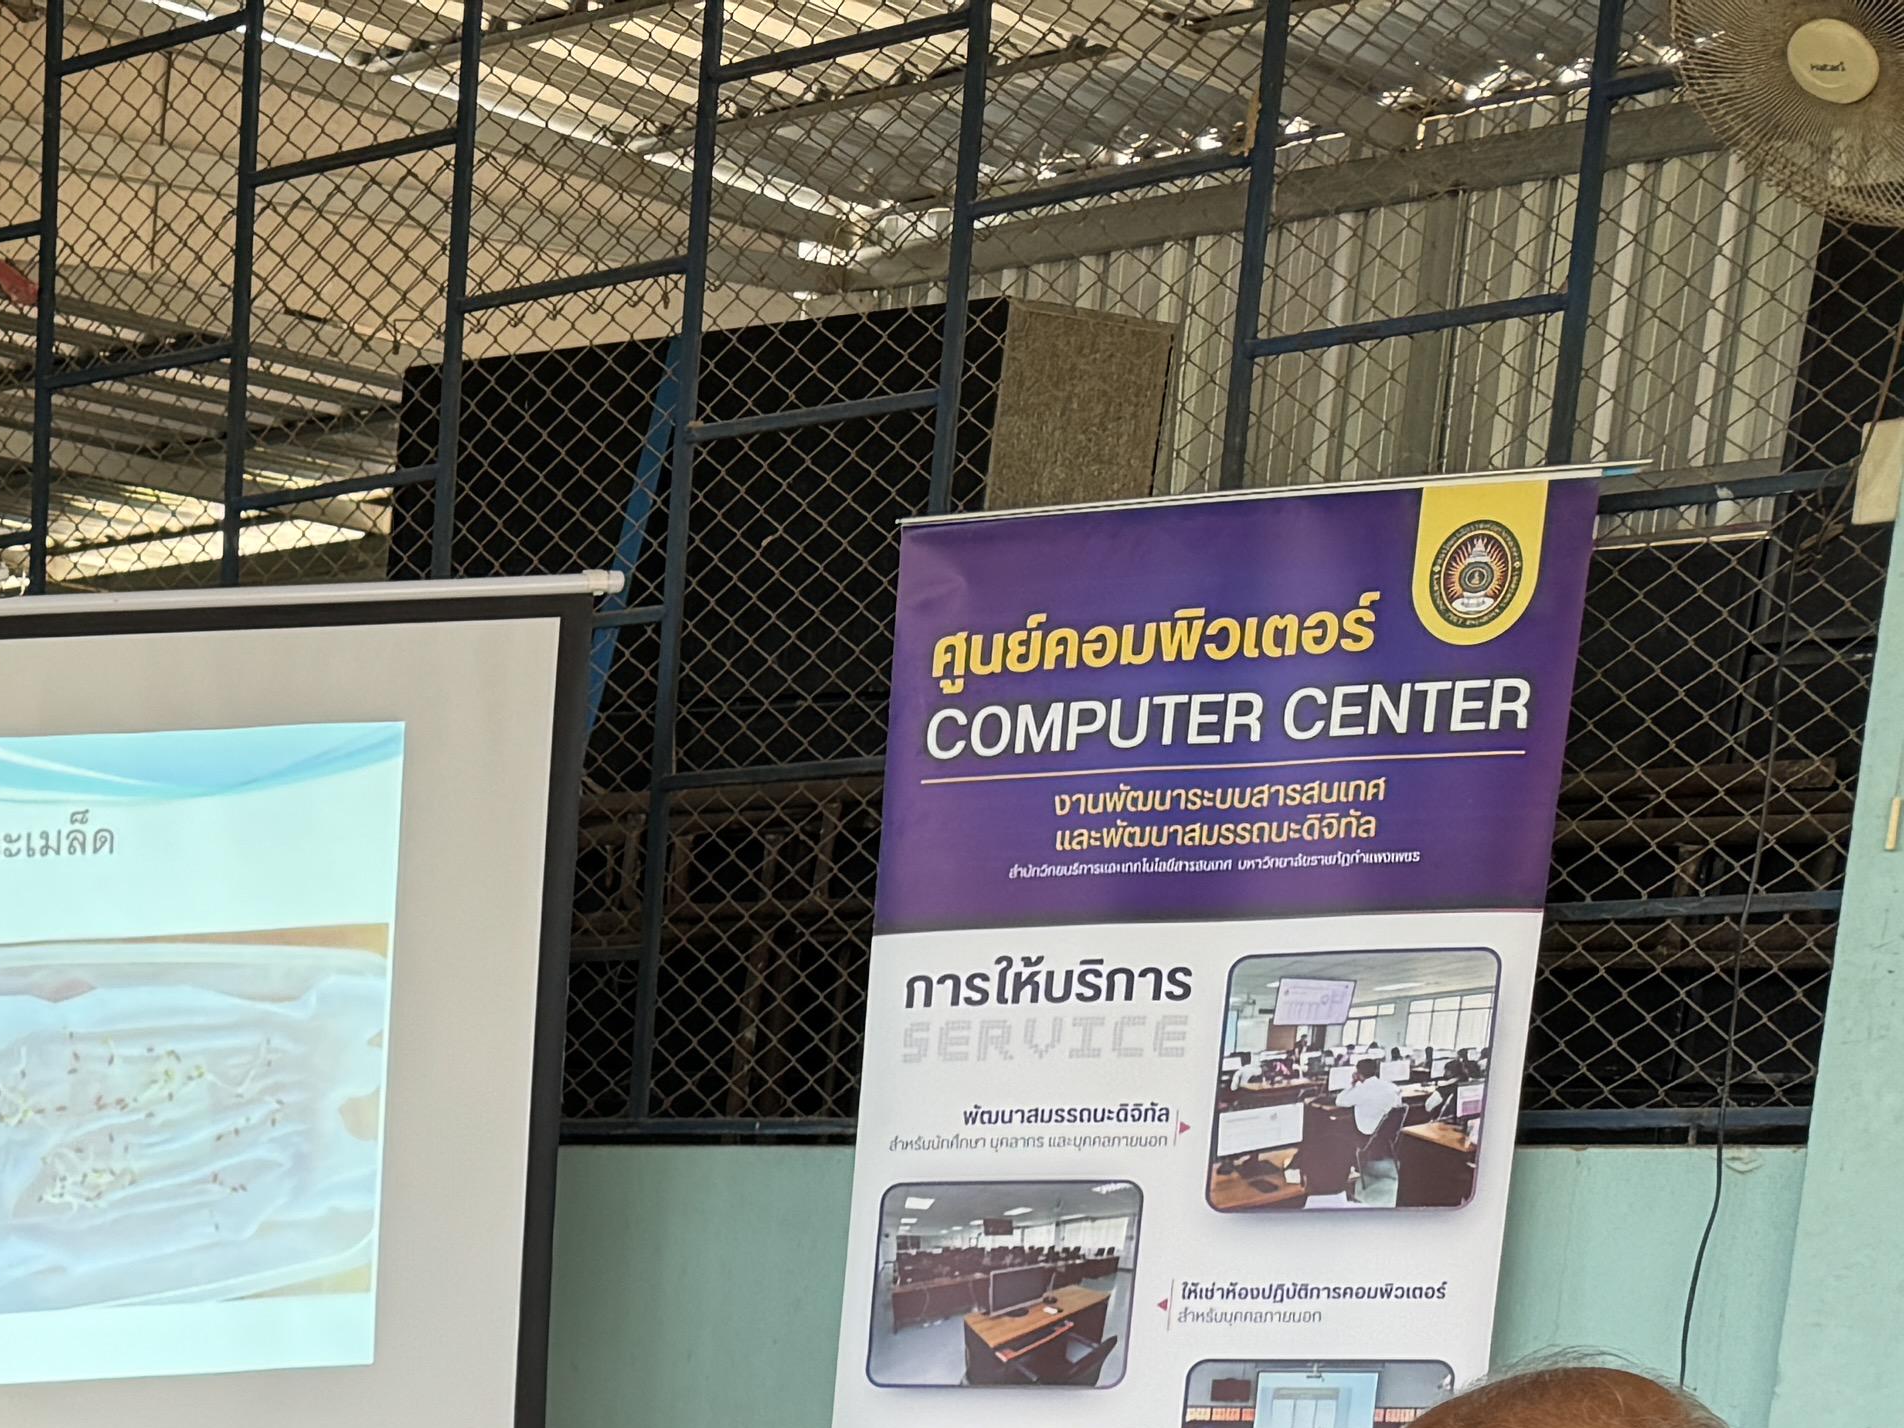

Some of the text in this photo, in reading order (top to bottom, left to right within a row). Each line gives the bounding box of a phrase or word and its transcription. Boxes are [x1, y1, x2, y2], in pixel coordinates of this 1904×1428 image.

[932, 591, 1381, 695] ศูนย์คอมพิวเตอร์
[925, 678, 1531, 761] COMPUTER CENTER
[1054, 775, 1386, 817] งานพัฒนาระบบสารสนเทศ
[1054, 809, 1376, 851] และพัฒนาสมรรถนะดิจิทัล
[905, 955, 1192, 1008] การให้บริการ
[901, 1014, 1188, 1064] SERVICE
[963, 1101, 1170, 1126] พัฒนาสมรรถนะดิจิทัล
